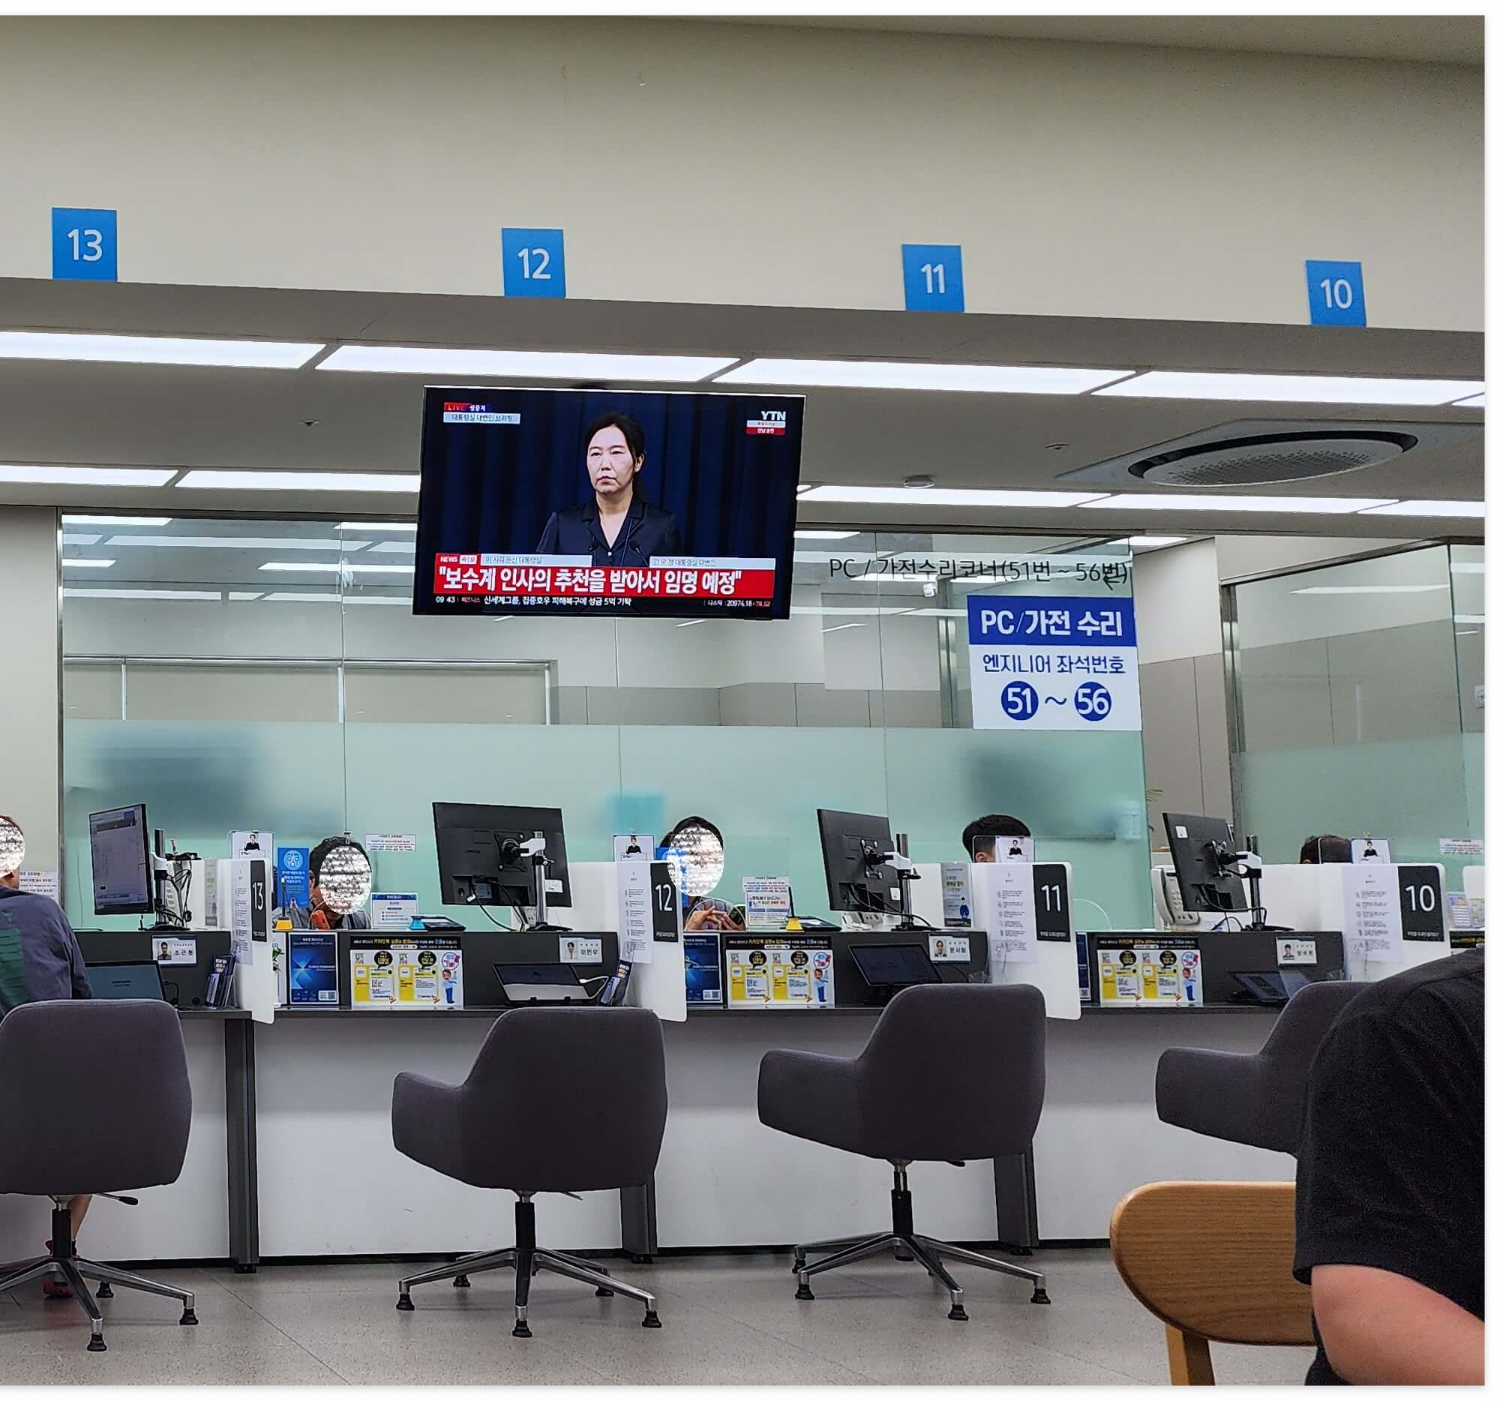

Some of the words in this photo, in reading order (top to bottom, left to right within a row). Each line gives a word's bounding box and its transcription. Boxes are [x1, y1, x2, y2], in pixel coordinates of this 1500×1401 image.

[68, 229, 103, 262] 13
[518, 249, 551, 279] 12
[921, 264, 945, 294] 11
[1321, 280, 1353, 309] 10
[761, 411, 787, 421] YTN
[500, 568, 551, 593] 인사의
[554, 568, 606, 593] 추천을
[610, 569, 661, 594] 받아서
[665, 570, 697, 595] 임명
[830, 559, 856, 578] PC
[1077, 611, 1123, 637] 수리
[983, 654, 1051, 674] 엔지니어
[1057, 655, 1126, 674] 좌석번호
[1007, 687, 1031, 714] 51
[1075, 687, 1109, 714] 56
[252, 881, 264, 910] 13
[655, 884, 673, 912] 12
[1041, 885, 1061, 912] 11
[1405, 885, 1435, 912] 10
